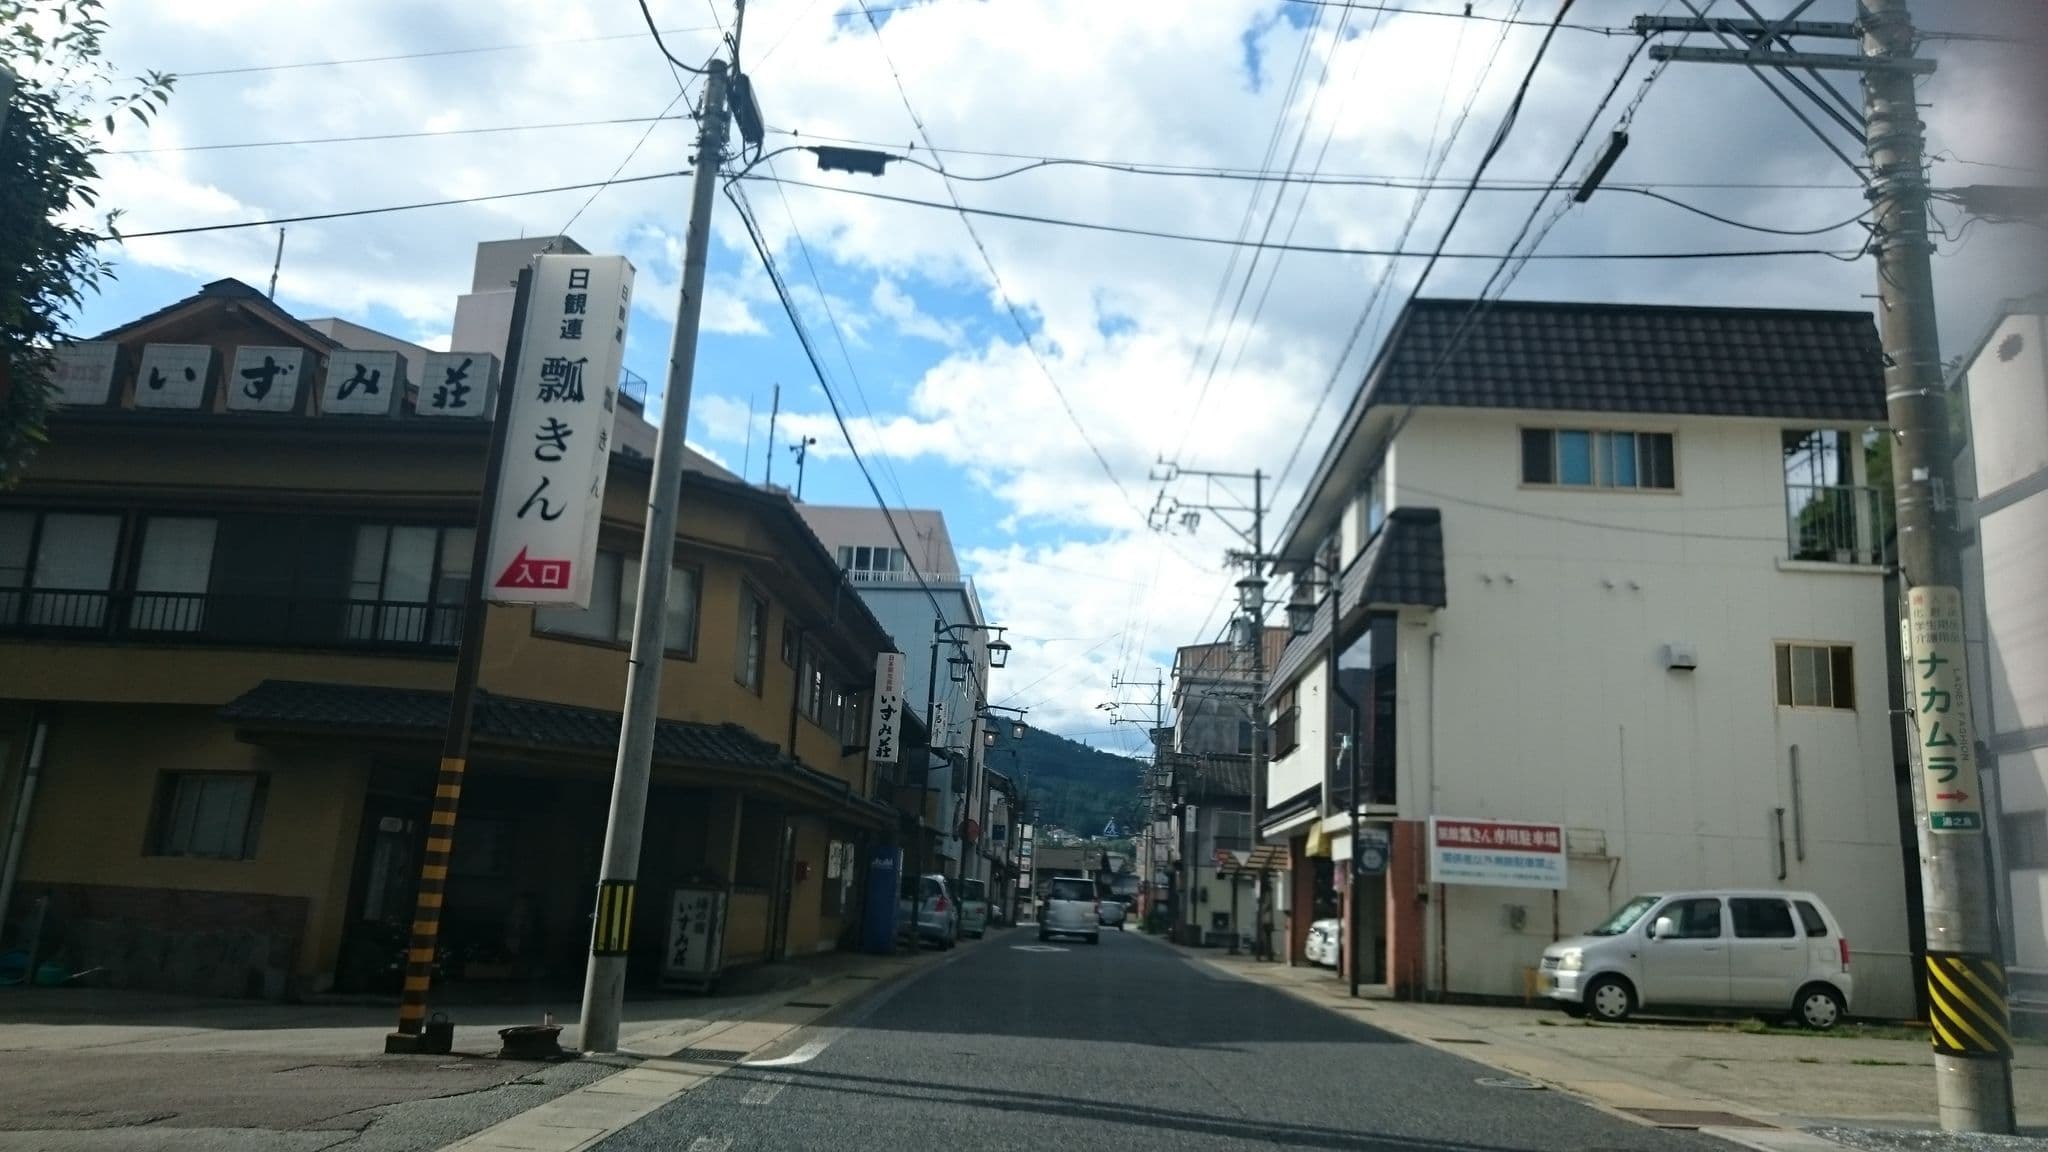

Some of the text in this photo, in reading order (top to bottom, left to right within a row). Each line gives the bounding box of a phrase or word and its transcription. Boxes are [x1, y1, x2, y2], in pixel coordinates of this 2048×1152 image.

[559, 268, 590, 340] 日観連
[149, 354, 473, 410] いずみ荘
[517, 356, 588, 521] 瓢きん
[515, 563, 561, 585] 入口
[875, 695, 897, 758] いずみ荘
[1918, 650, 1960, 783] ナカムラ
[1957, 712, 1970, 761] FASHION
